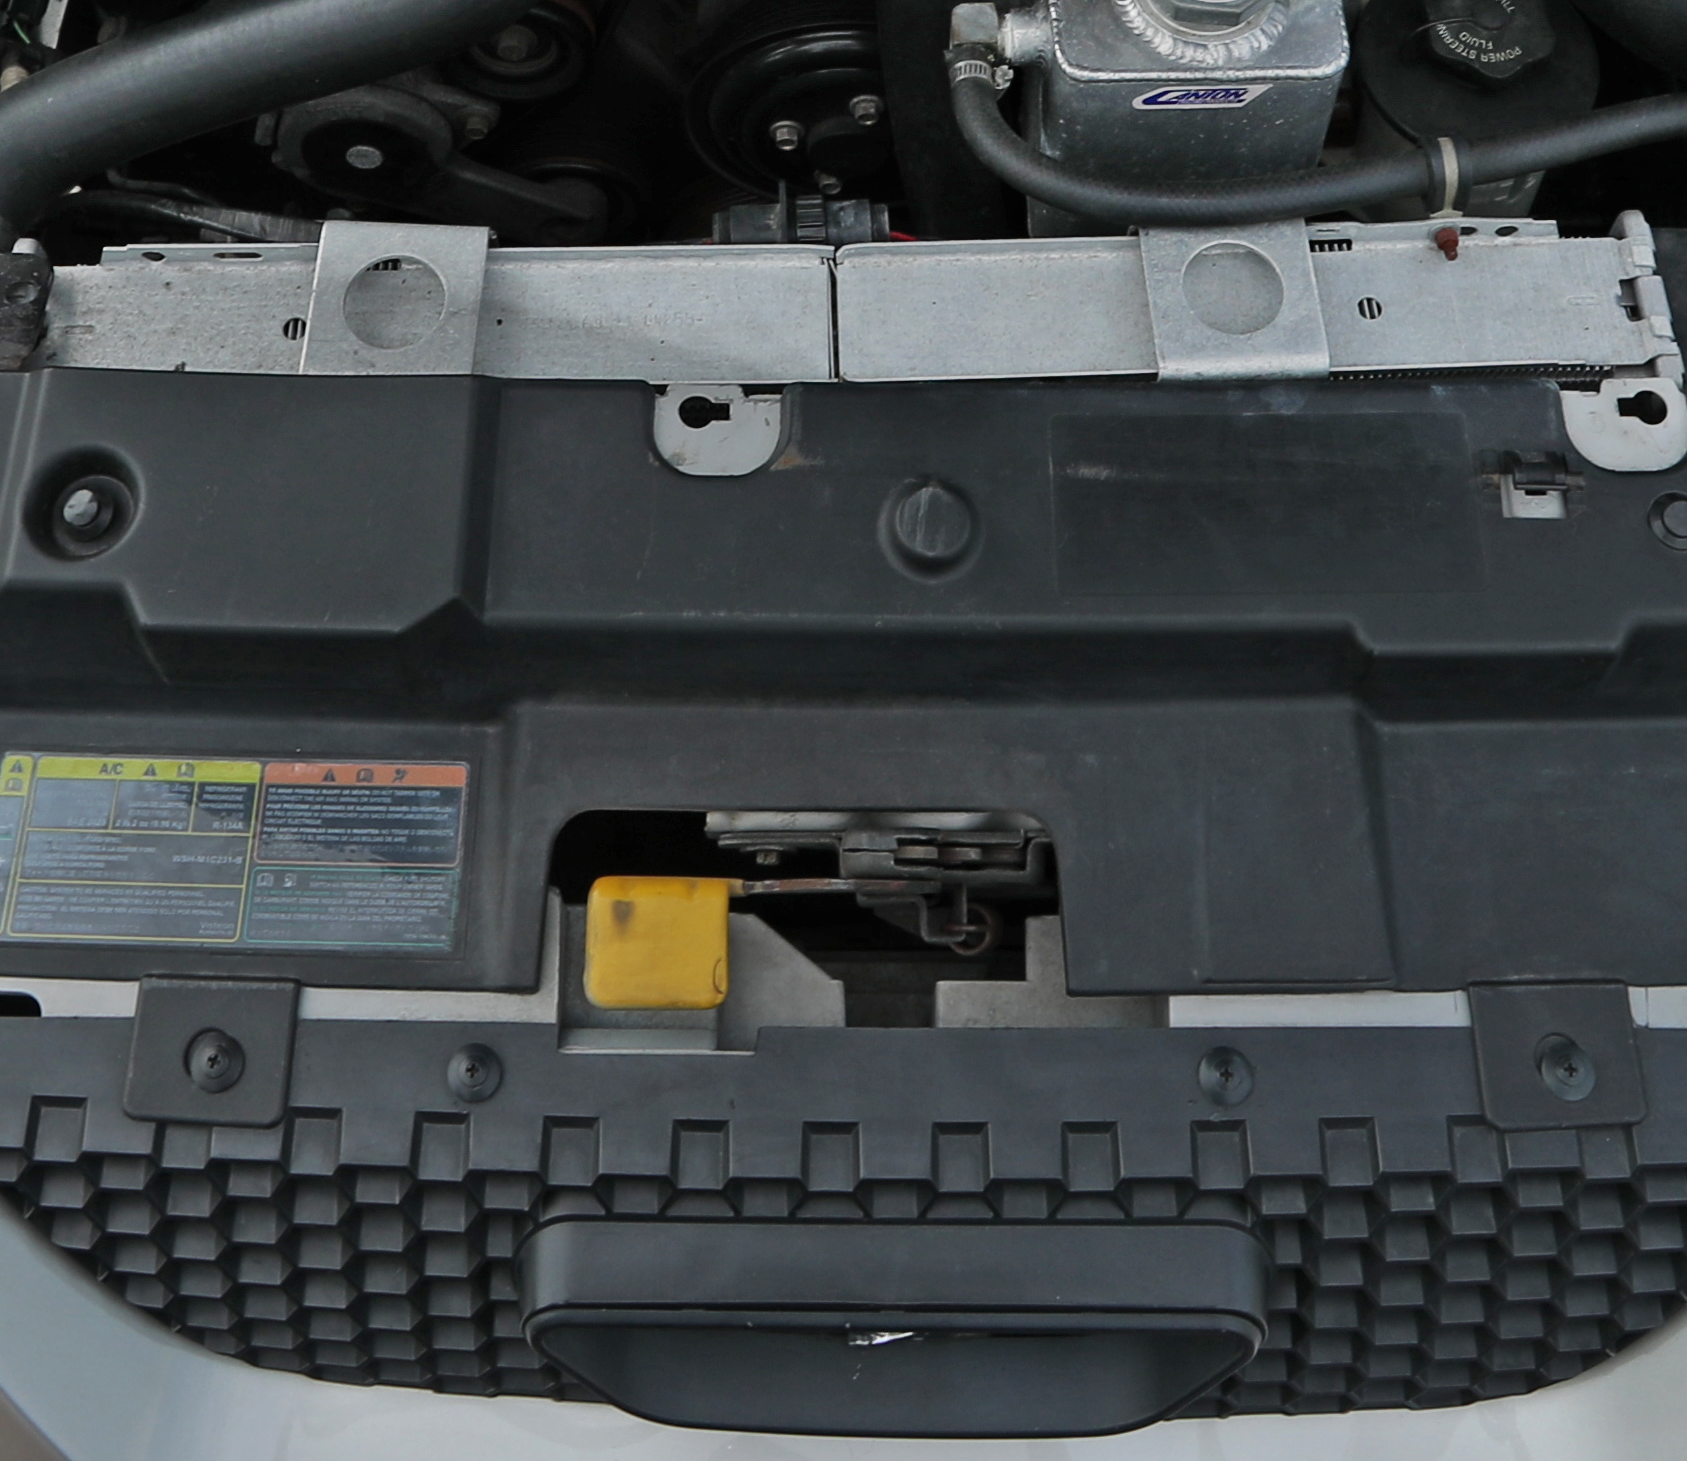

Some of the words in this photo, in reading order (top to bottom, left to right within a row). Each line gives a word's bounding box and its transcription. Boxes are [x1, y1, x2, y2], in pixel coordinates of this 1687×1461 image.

[1459, 31, 1493, 50] FLUID
[1480, 46, 1523, 63] POWER
[99, 762, 124, 776] A/C
